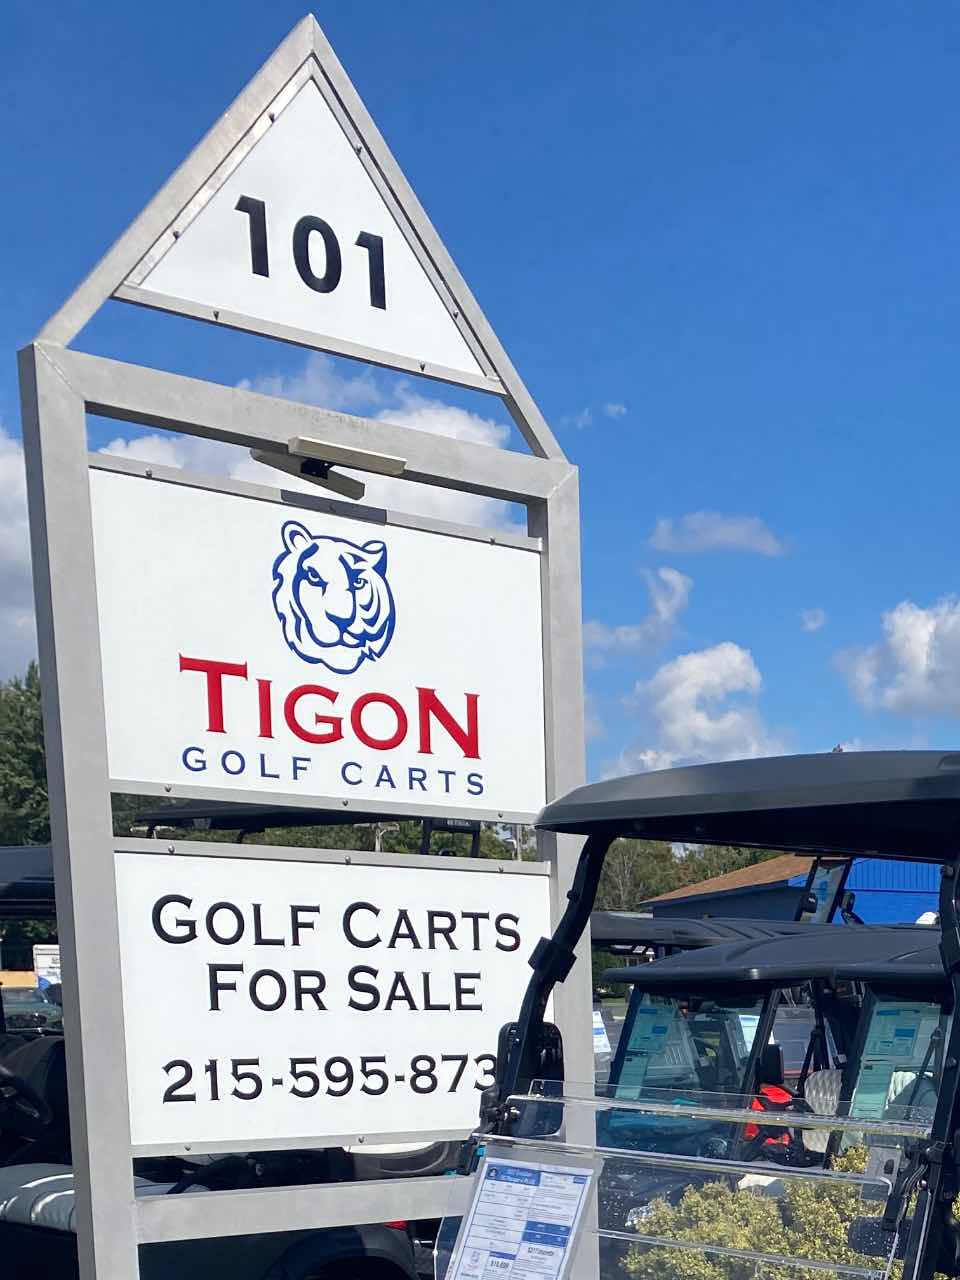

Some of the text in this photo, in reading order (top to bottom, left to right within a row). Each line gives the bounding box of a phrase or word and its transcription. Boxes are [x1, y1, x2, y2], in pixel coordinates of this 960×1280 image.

[235, 194, 387, 311] 101
[179, 653, 481, 760] TIGON
[182, 746, 485, 796] GOLF CARTS
[151, 894, 522, 953] GOLF CARTS
[207, 962, 484, 1012] FOR SALE
[161, 1053, 498, 1105] 215-595-873
